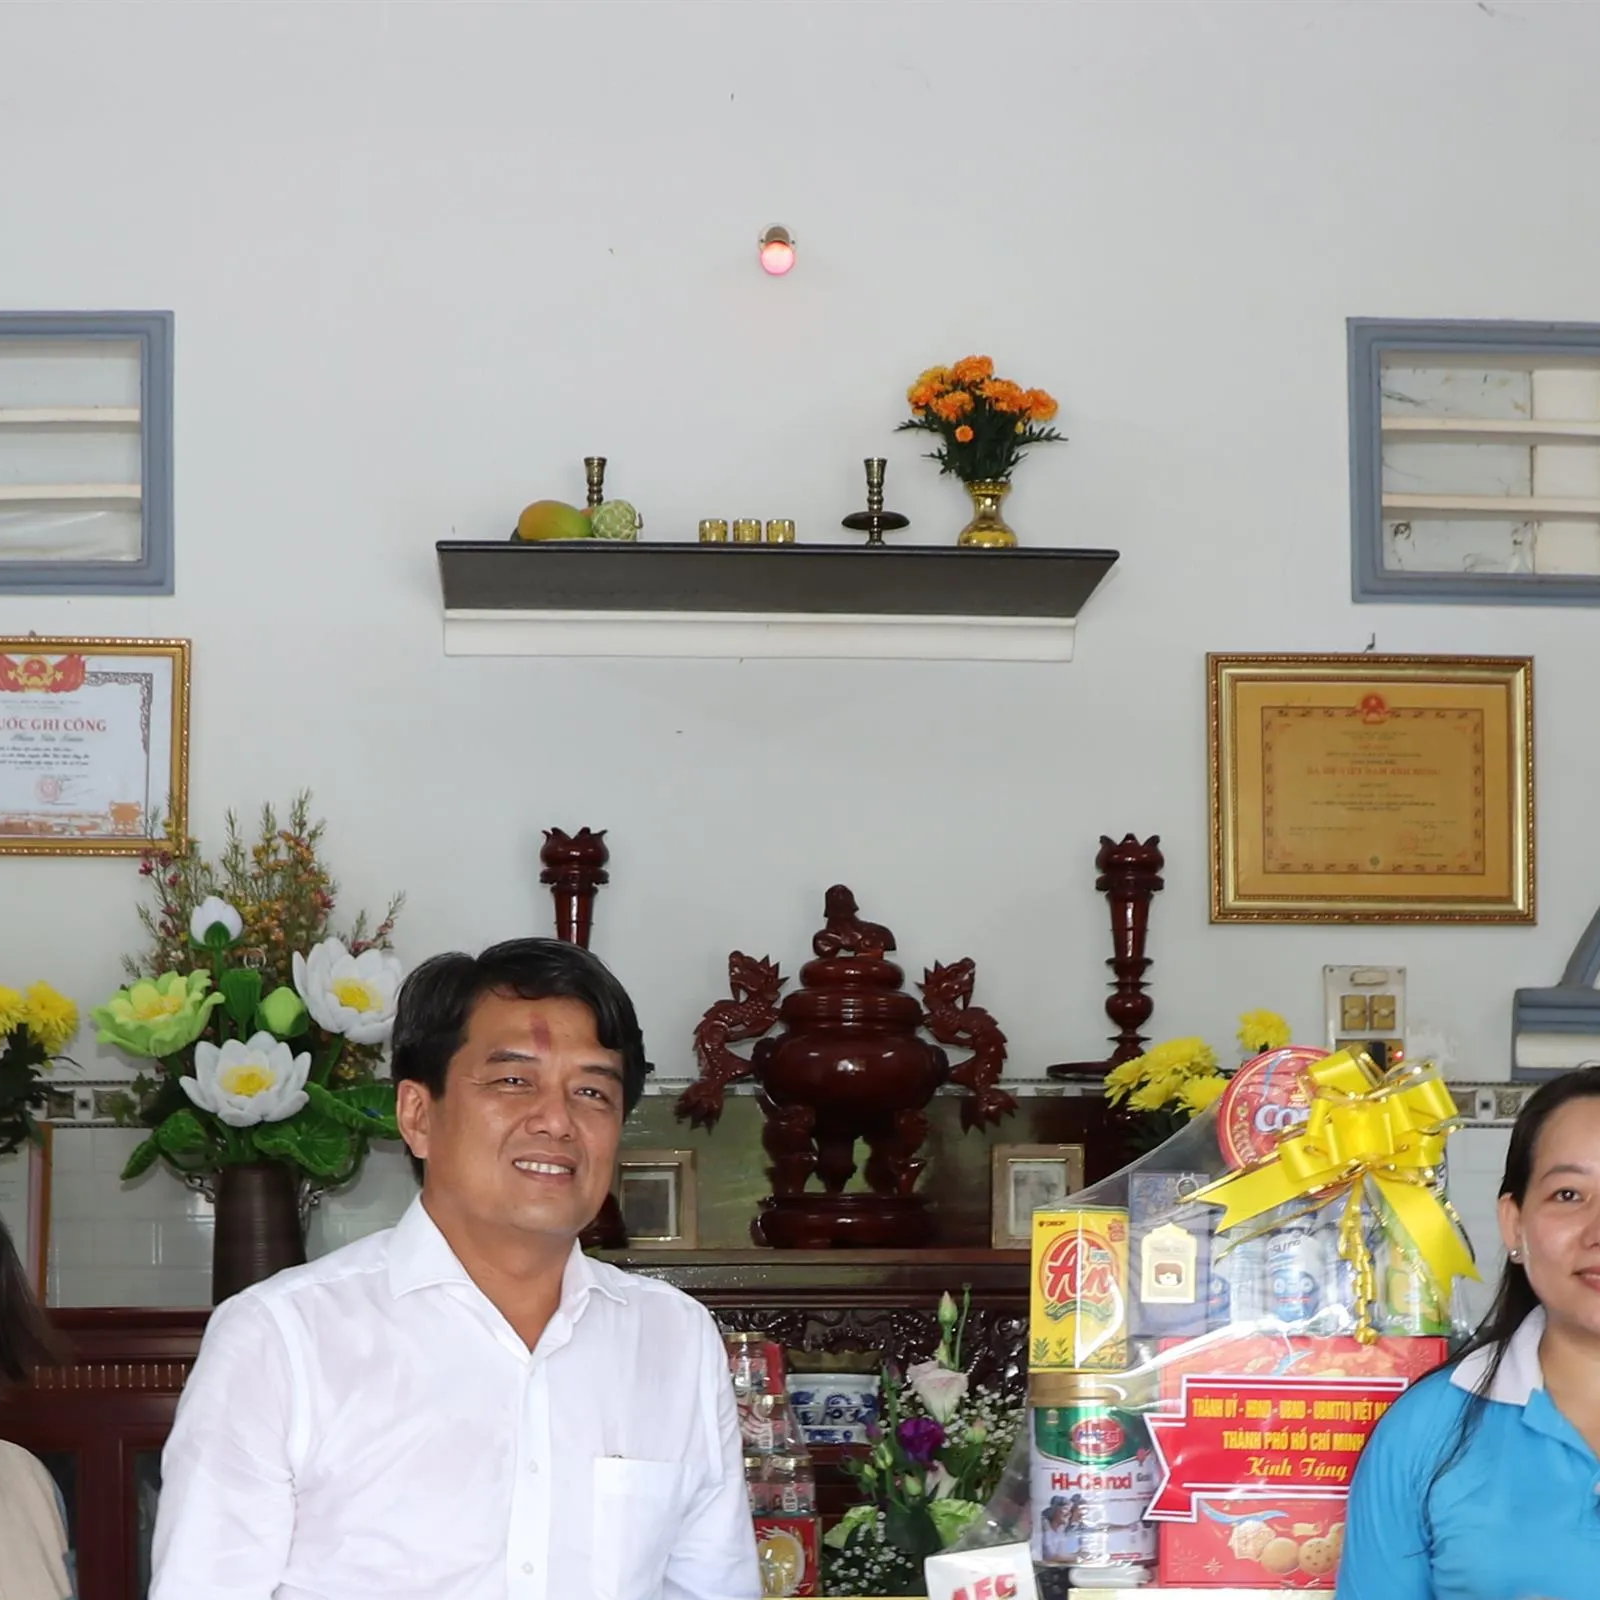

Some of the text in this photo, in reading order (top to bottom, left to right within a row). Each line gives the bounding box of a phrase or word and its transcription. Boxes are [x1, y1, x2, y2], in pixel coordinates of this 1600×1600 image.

[30, 717, 60, 731] GHI
[63, 716, 107, 732] CÔNG
[1222, 1427, 1262, 1450] THÀNH
[1263, 1425, 1289, 1450] PHỐ
[1310, 1428, 1331, 1451] CHÍ
[1245, 1455, 1348, 1481] Kính Tặng
[1051, 1472, 1133, 1490] Hi-Canxi
